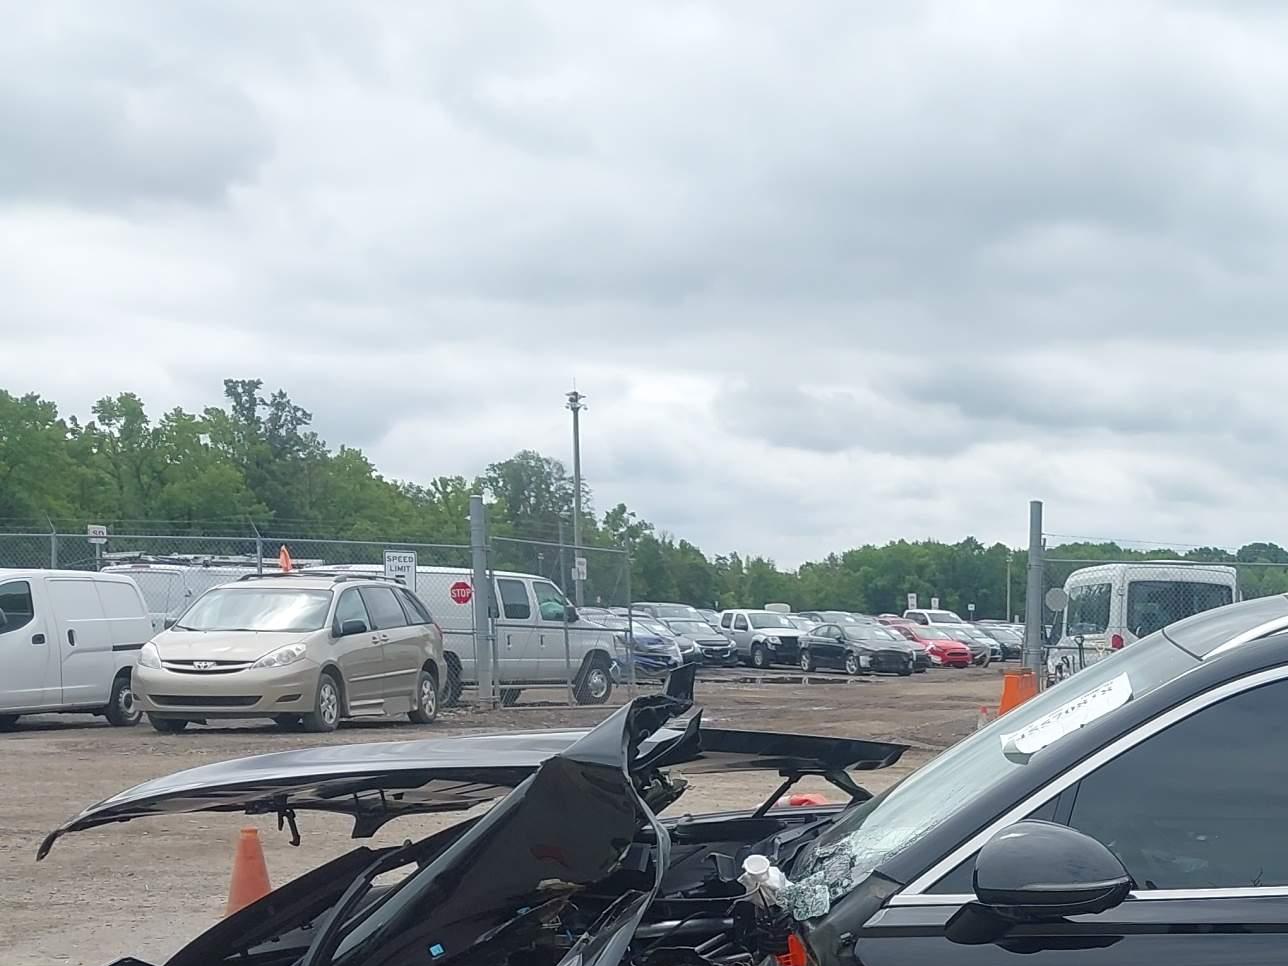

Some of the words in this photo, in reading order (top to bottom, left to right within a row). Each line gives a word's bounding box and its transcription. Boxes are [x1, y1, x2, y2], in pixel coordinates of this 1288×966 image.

[386, 555, 414, 563] SPEED
[389, 565, 411, 573] LIMIT
[451, 588, 471, 598] STOP
